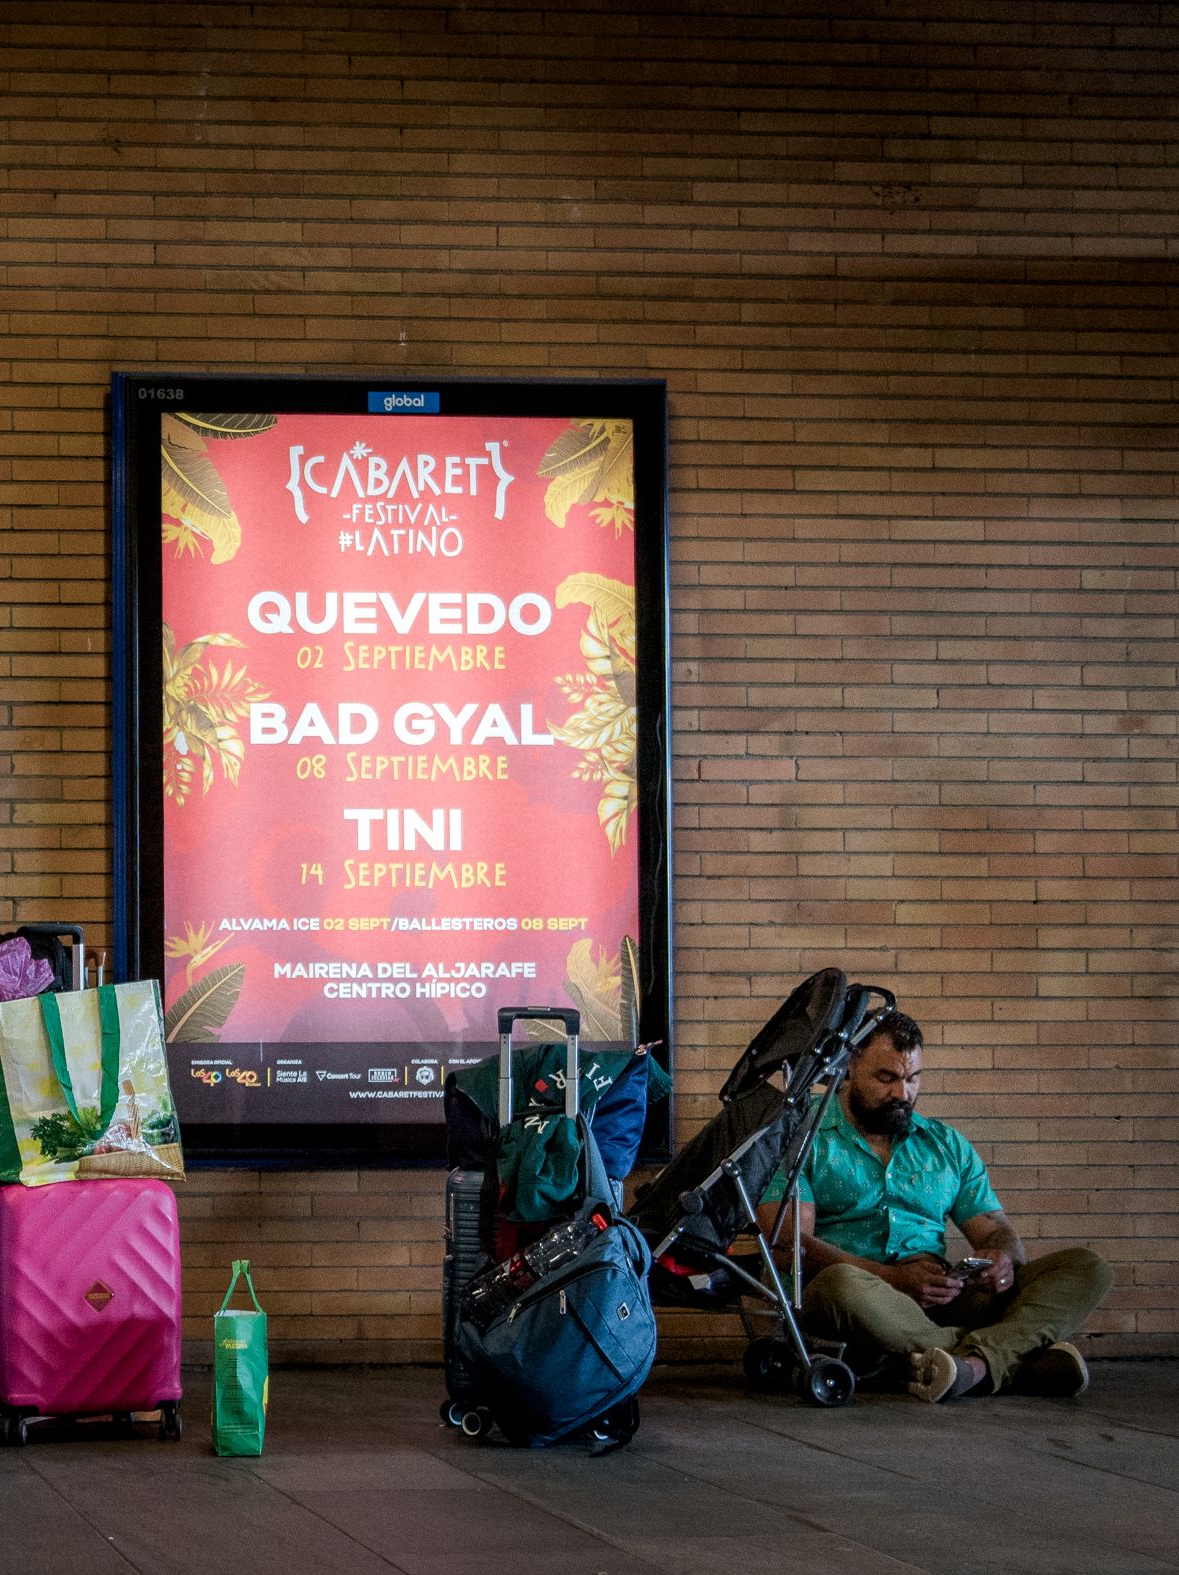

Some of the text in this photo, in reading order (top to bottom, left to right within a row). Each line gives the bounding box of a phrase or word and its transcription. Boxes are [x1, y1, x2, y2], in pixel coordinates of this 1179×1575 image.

[138, 388, 185, 400] 01638
[384, 394, 424, 411] global
[338, 526, 463, 557] #LATINO
[247, 589, 553, 636] QUEVEDO
[296, 641, 507, 672] 02 SEPTIEMBRE
[249, 702, 555, 746] BAD GYAL
[295, 752, 509, 782] 08 SEPTIEMBRE
[343, 808, 463, 850] TINI
[300, 859, 507, 889] 14 SEPTIEMBRE
[218, 918, 290, 931] ALVAMA
[293, 918, 320, 931] ICE
[323, 918, 345, 931] 02
[521, 917, 544, 931] 08
[546, 918, 589, 931] SEPT
[273, 962, 537, 979] MAIRENA DEL ALJARAFE
[323, 978, 487, 999] CENTRO HÍPICO
[276, 1070, 297, 1078] Siente
[326, 1073, 349, 1081] Concert
